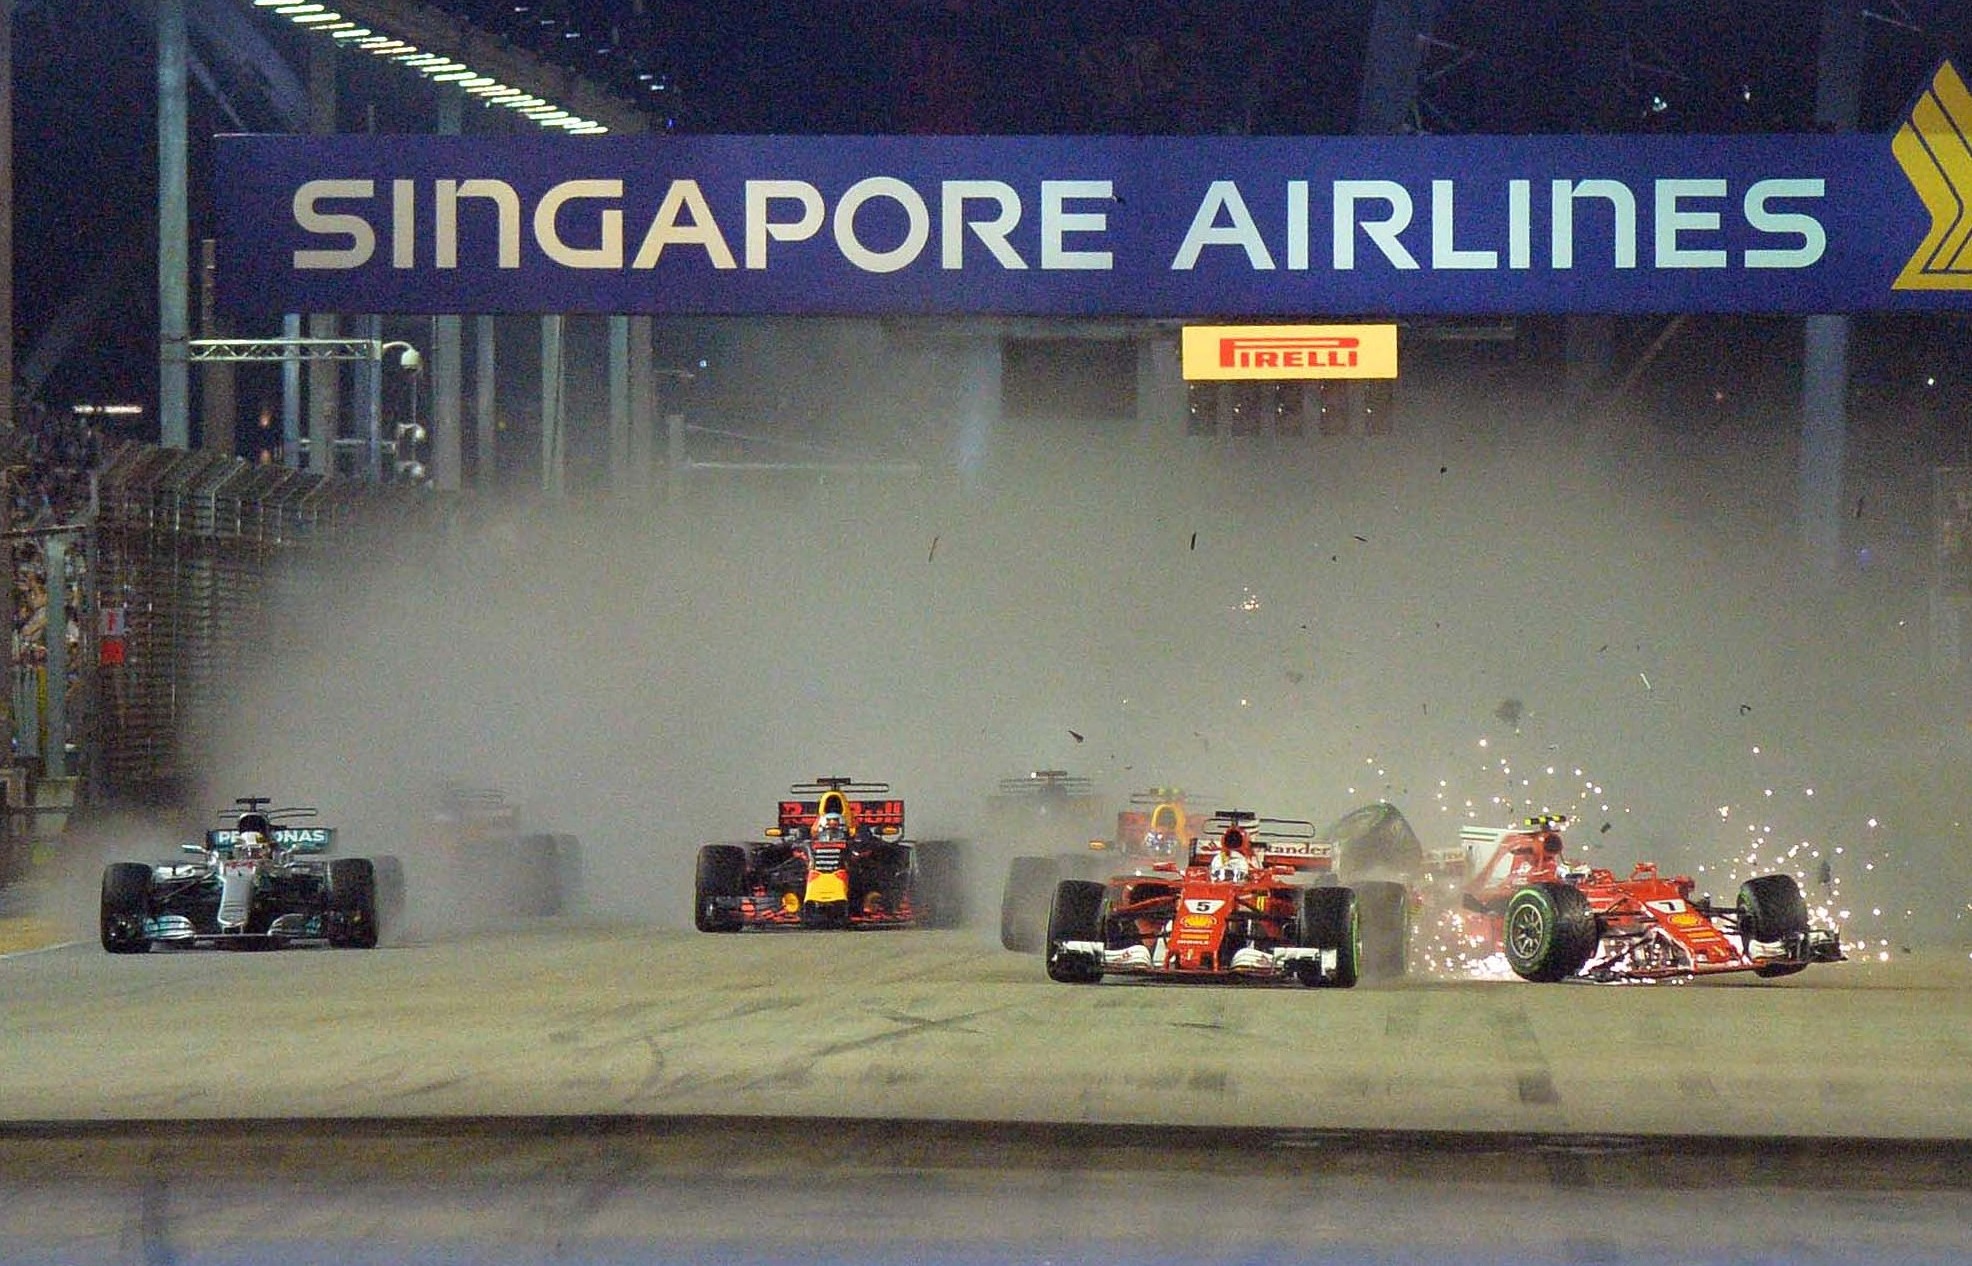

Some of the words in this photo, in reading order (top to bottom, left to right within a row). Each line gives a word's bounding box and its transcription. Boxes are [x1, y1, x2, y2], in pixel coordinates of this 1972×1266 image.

[292, 176, 1113, 272] SINGAPORE
[1171, 179, 1826, 269] AIRLINES
[1219, 337, 1359, 367] PIRELLI
[219, 829, 326, 843] PEONAS
[1196, 901, 1212, 912] 5
